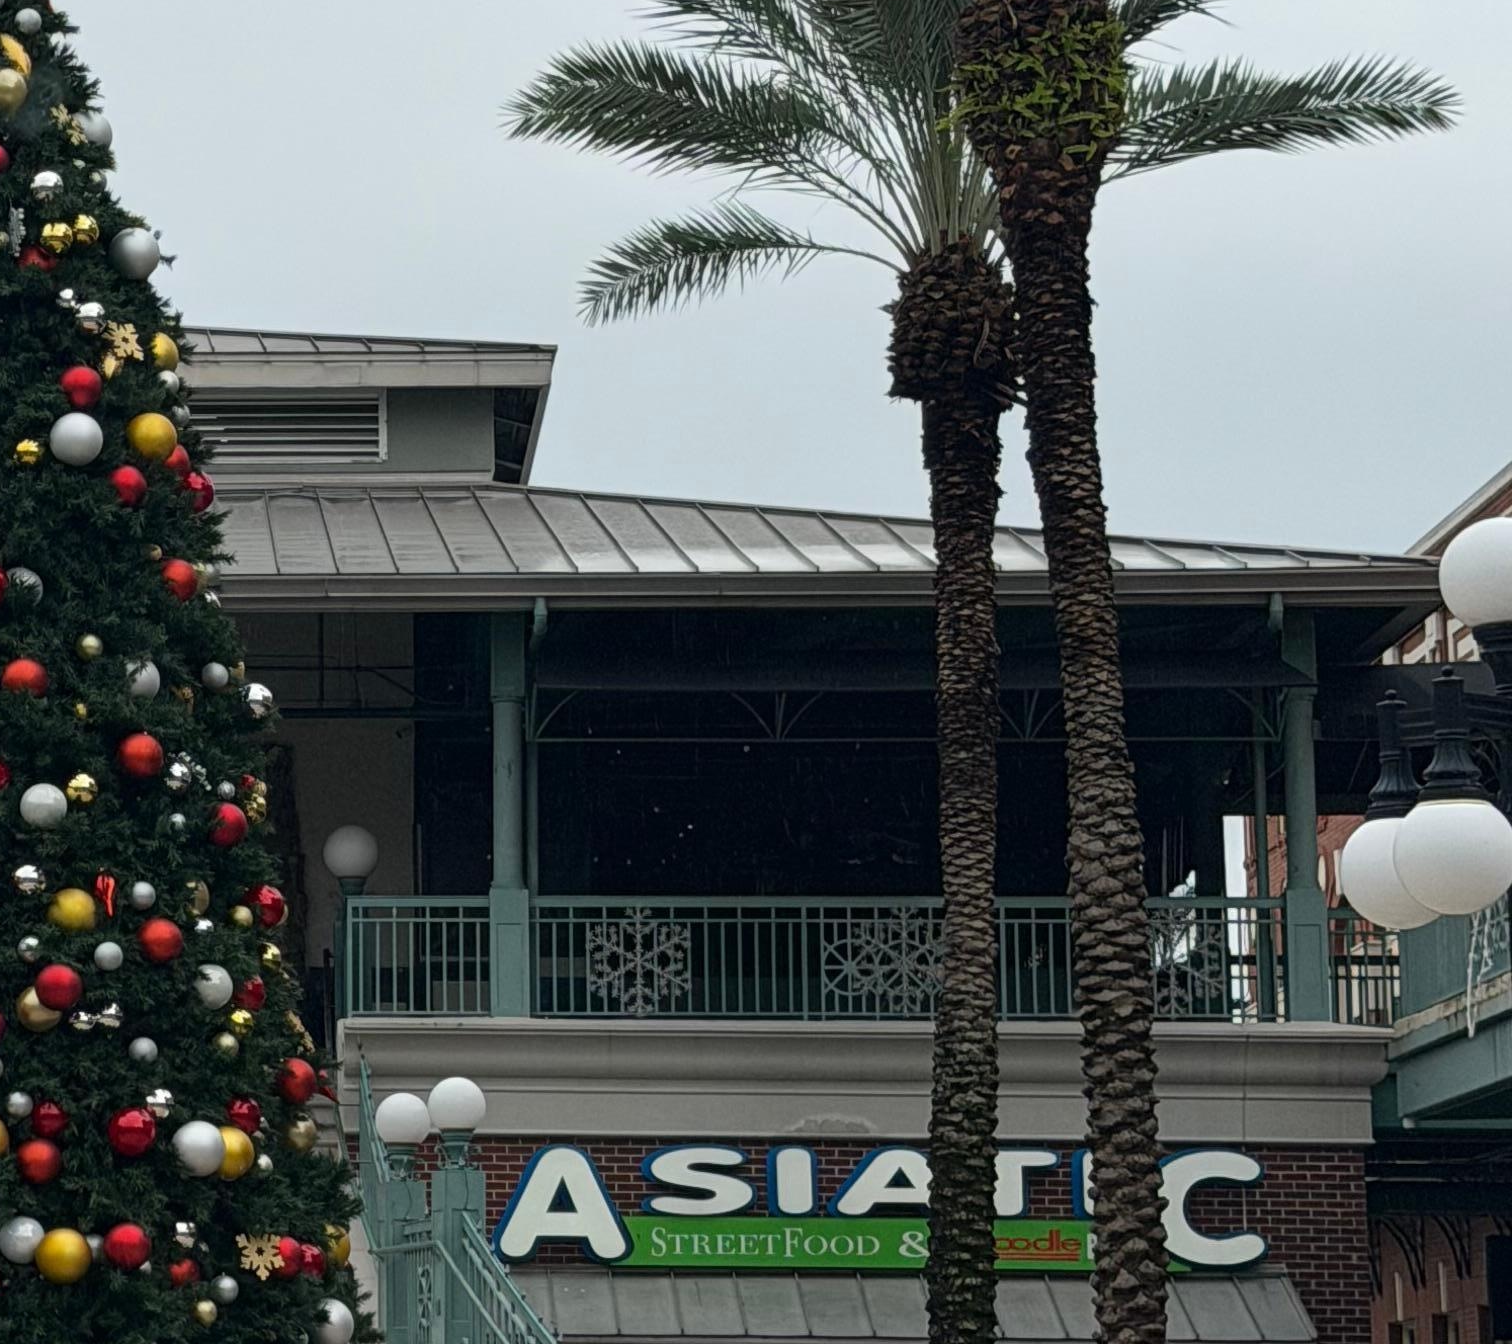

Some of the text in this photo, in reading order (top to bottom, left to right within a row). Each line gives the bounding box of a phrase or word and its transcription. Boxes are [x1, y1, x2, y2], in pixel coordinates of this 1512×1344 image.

[494, 1146, 1268, 1267] ASIATC
[898, 1231, 930, 1257] &
[995, 1229, 1082, 1253] oodle
